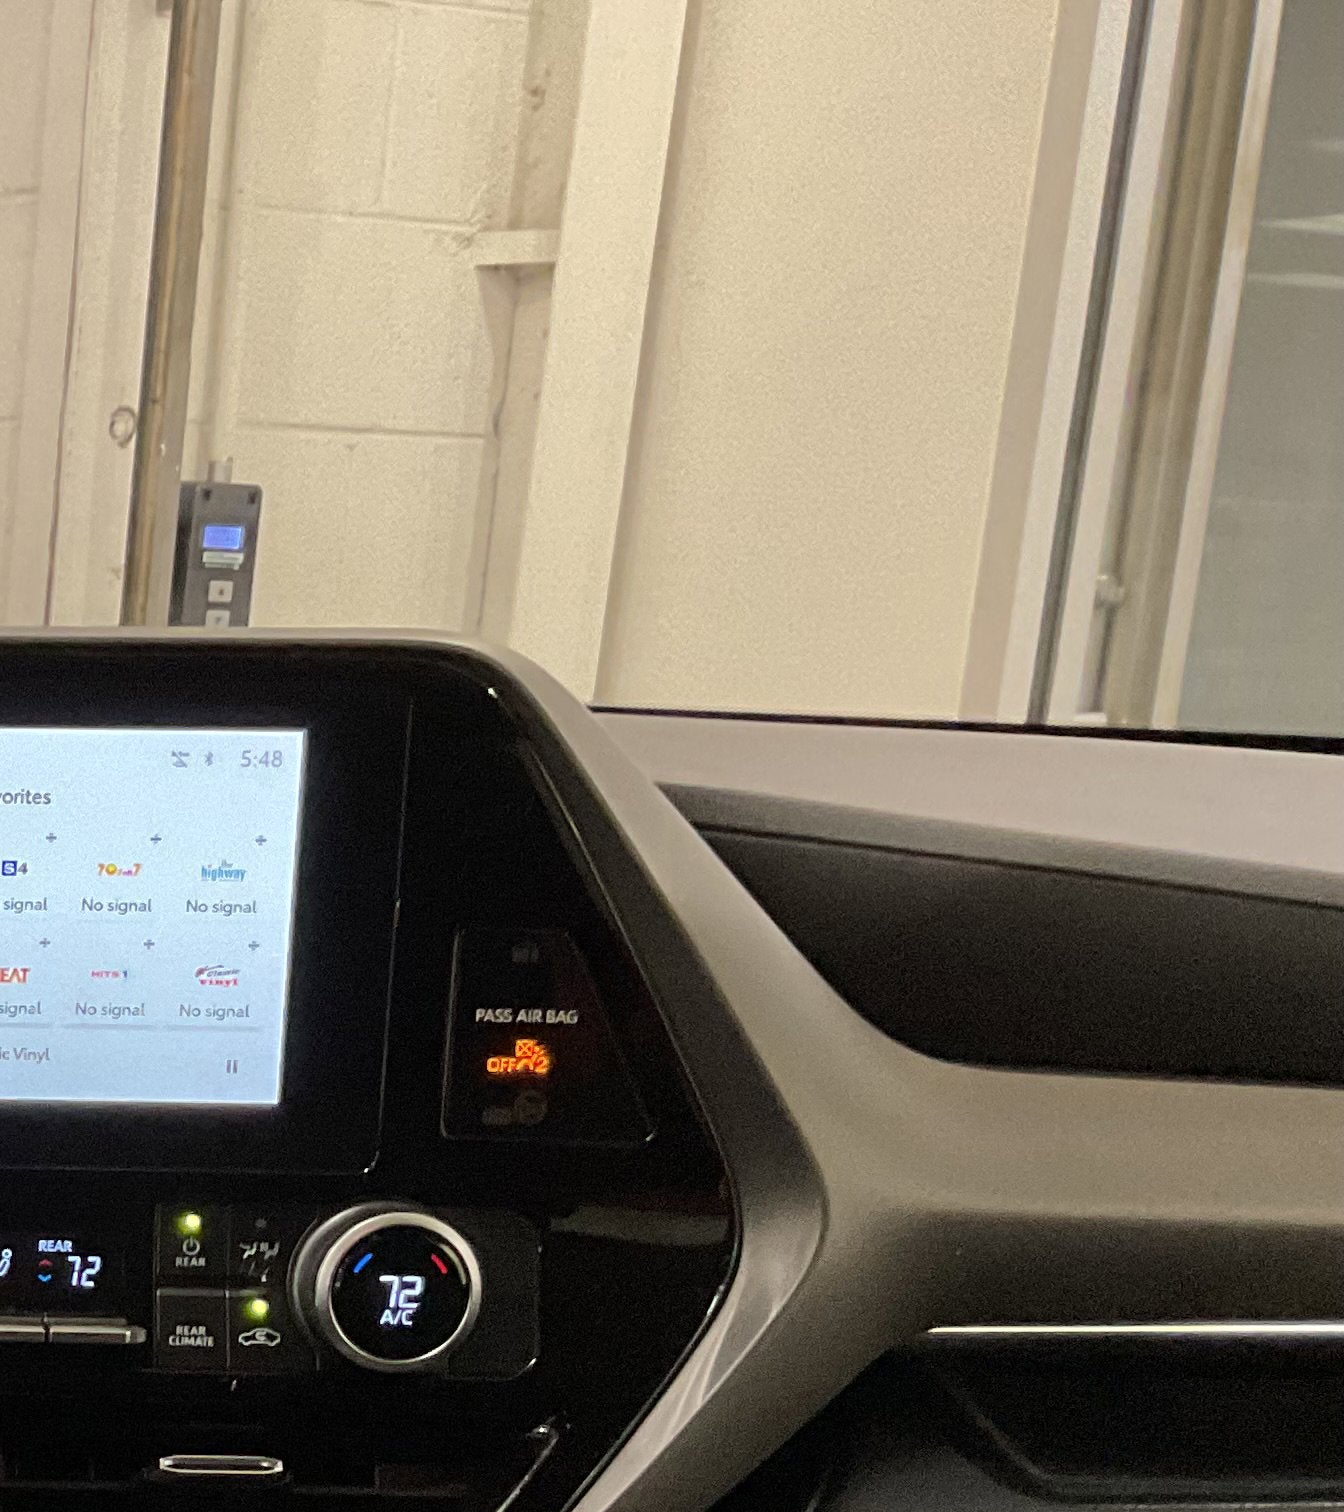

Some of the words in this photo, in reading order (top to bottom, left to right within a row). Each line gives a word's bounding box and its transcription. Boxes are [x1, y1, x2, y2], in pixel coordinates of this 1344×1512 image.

[240, 750, 283, 769] 5:48
[201, 863, 247, 881] highway
[3, 896, 48, 914] signal
[81, 898, 103, 912] No
[107, 898, 152, 915] signal
[186, 900, 208, 914] No
[212, 900, 257, 917] signal
[0, 1000, 42, 1019] signal
[75, 1002, 99, 1018] No
[103, 1002, 145, 1021] signal
[179, 1004, 203, 1019] No
[207, 1003, 250, 1023] signal
[475, 1008, 512, 1023] PASS
[516, 1009, 543, 1023] AIR
[546, 1010, 578, 1024] BAG
[12, 1047, 50, 1065] Vinyl
[487, 1057, 516, 1073] OFF
[38, 1240, 72, 1252] REAR
[175, 1257, 206, 1267] REAR
[68, 1256, 102, 1287] 72
[379, 1275, 425, 1308] 72
[379, 1310, 413, 1326] A/C
[175, 1325, 206, 1336] REAR
[169, 1336, 214, 1347] CLIMATE
